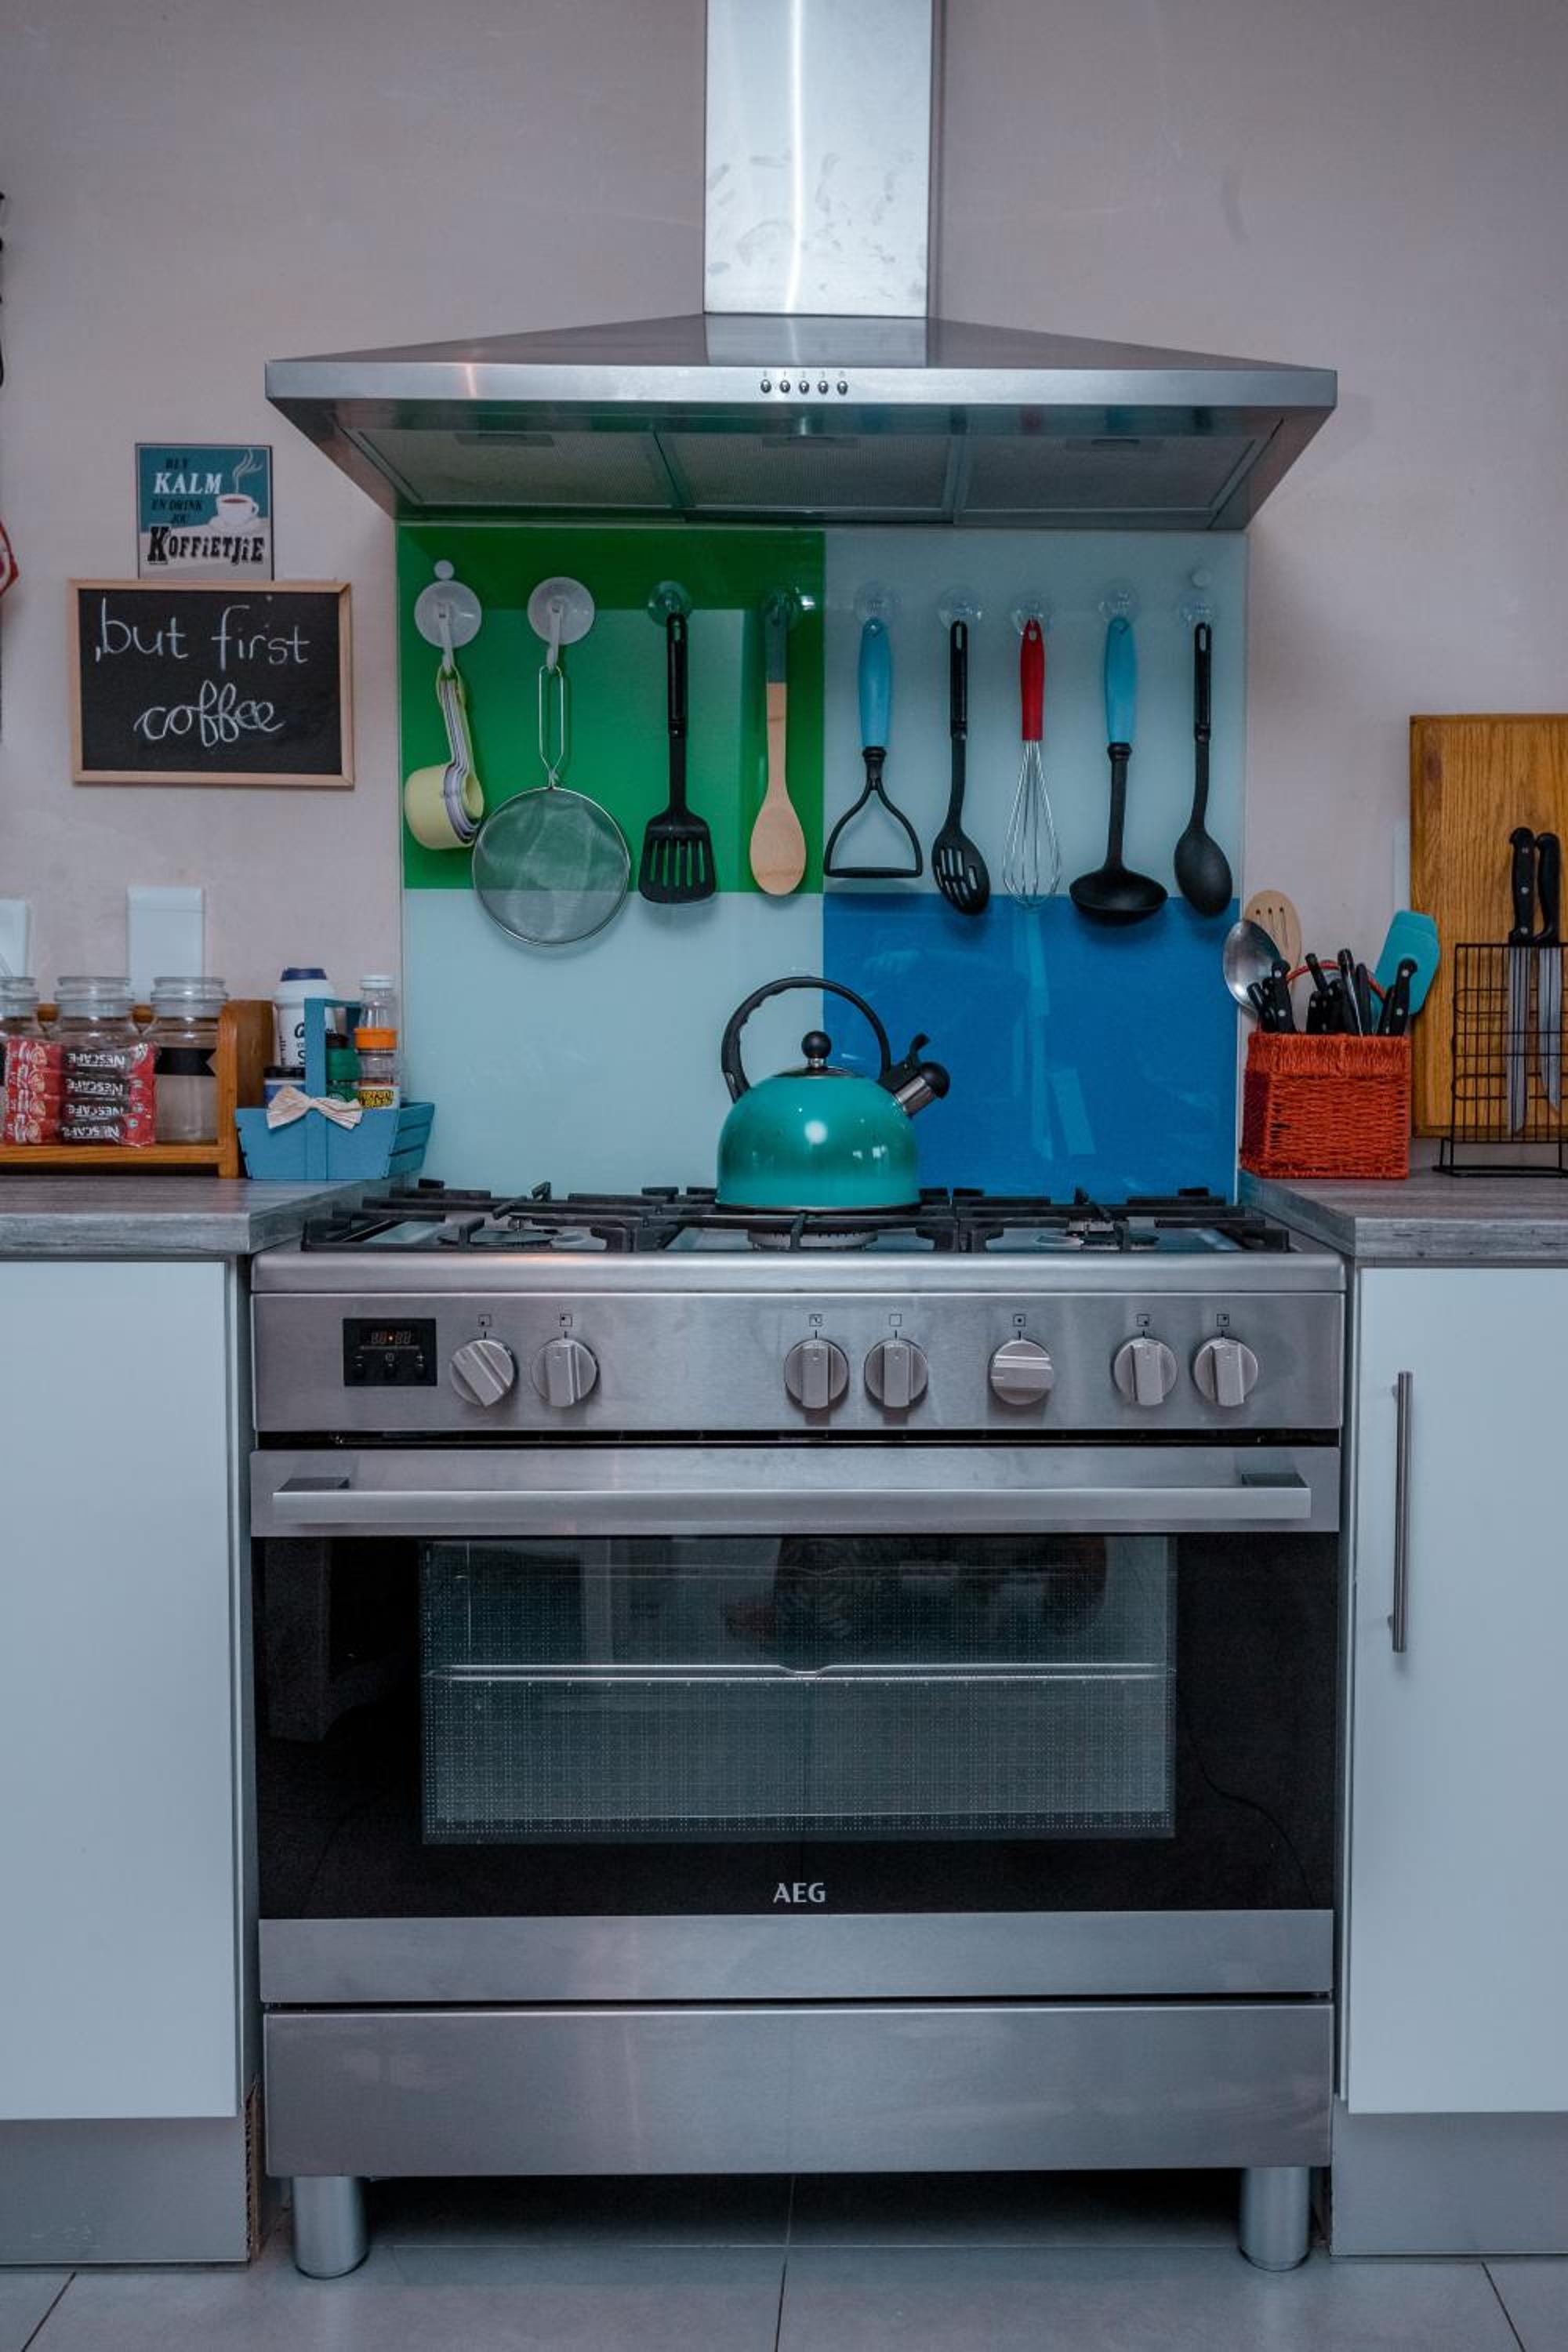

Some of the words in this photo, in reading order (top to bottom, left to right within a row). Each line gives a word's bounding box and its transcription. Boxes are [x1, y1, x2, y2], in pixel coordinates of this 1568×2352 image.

[154, 473, 223, 494] KALM
[211, 605, 310, 672] first
[133, 680, 287, 747] coffee
[773, 1882, 826, 1904] AEG
